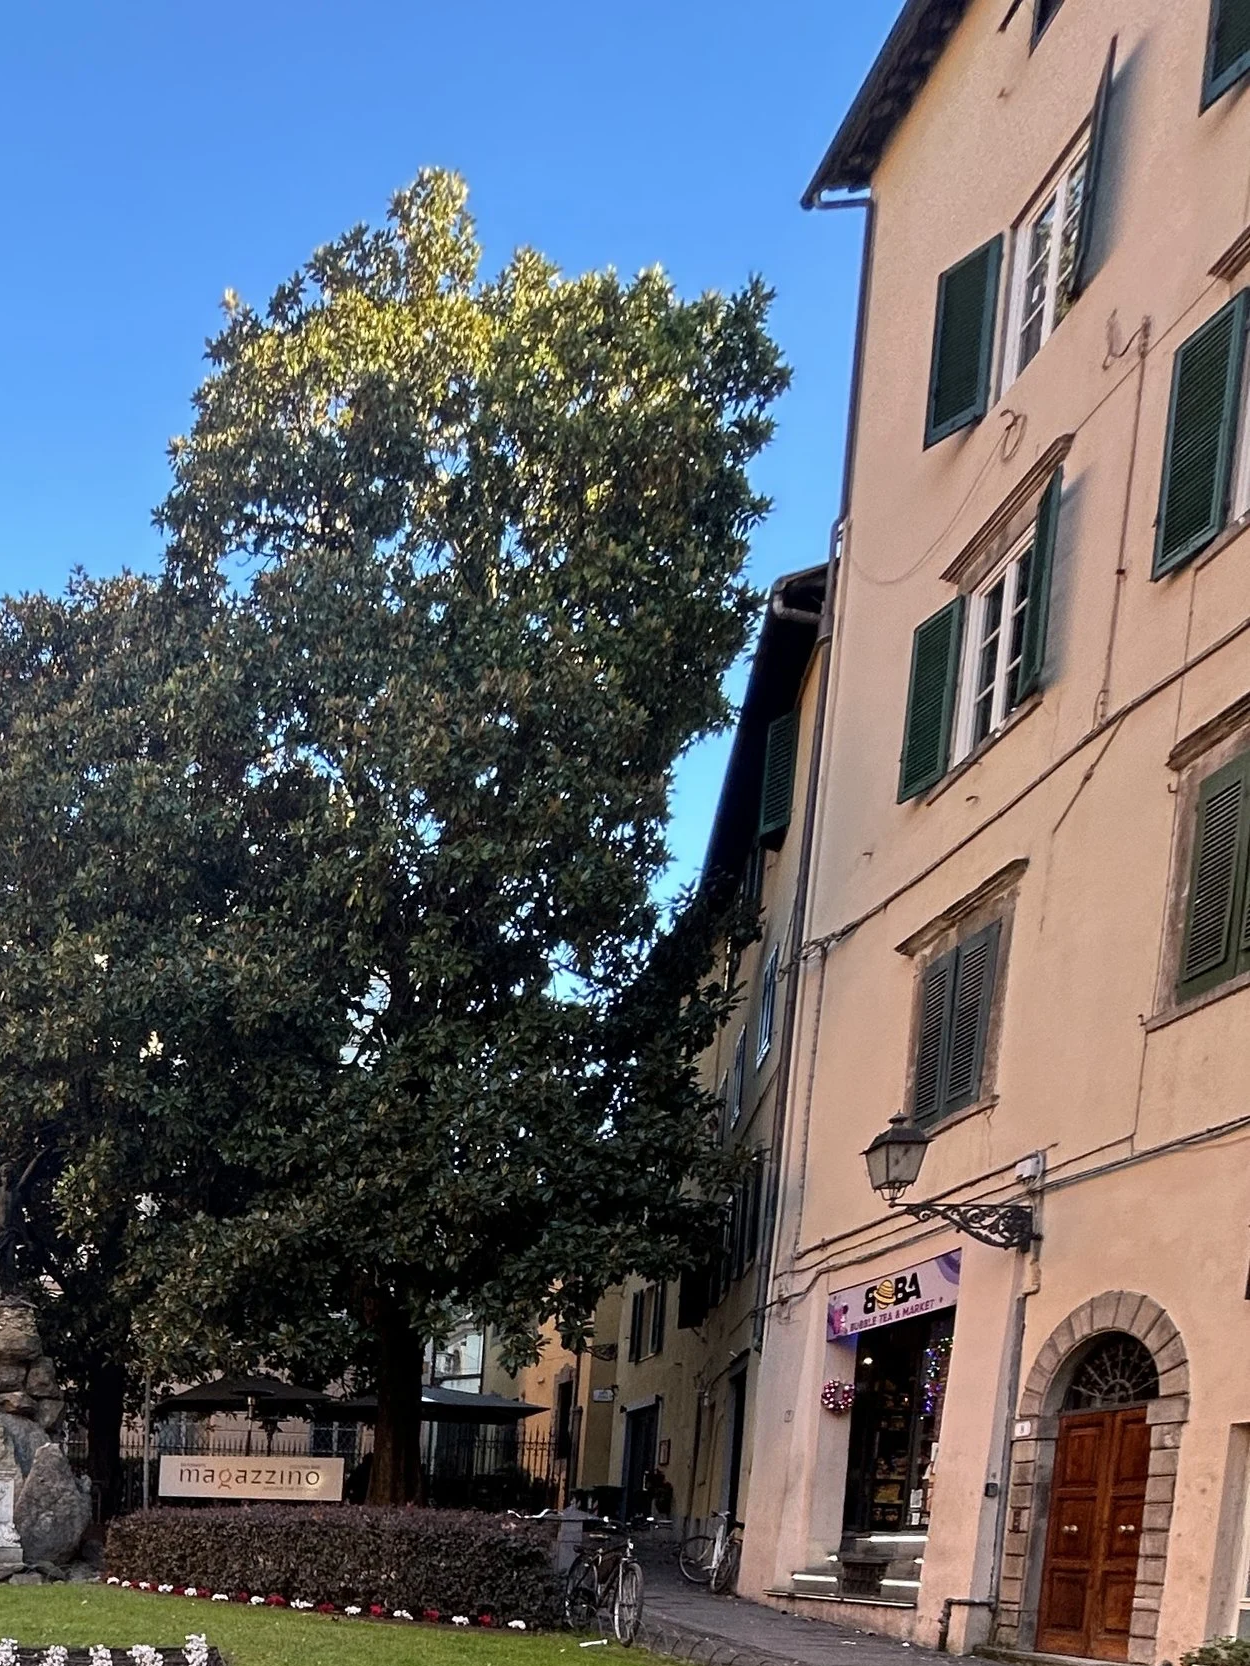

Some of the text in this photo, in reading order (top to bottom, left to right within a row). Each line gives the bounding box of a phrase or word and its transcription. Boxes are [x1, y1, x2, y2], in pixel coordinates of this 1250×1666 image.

[863, 1272, 922, 1315] BOBA
[850, 1299, 936, 1332] BUBBLE TEA & MARKET
[179, 1467, 320, 1490] magazzino
